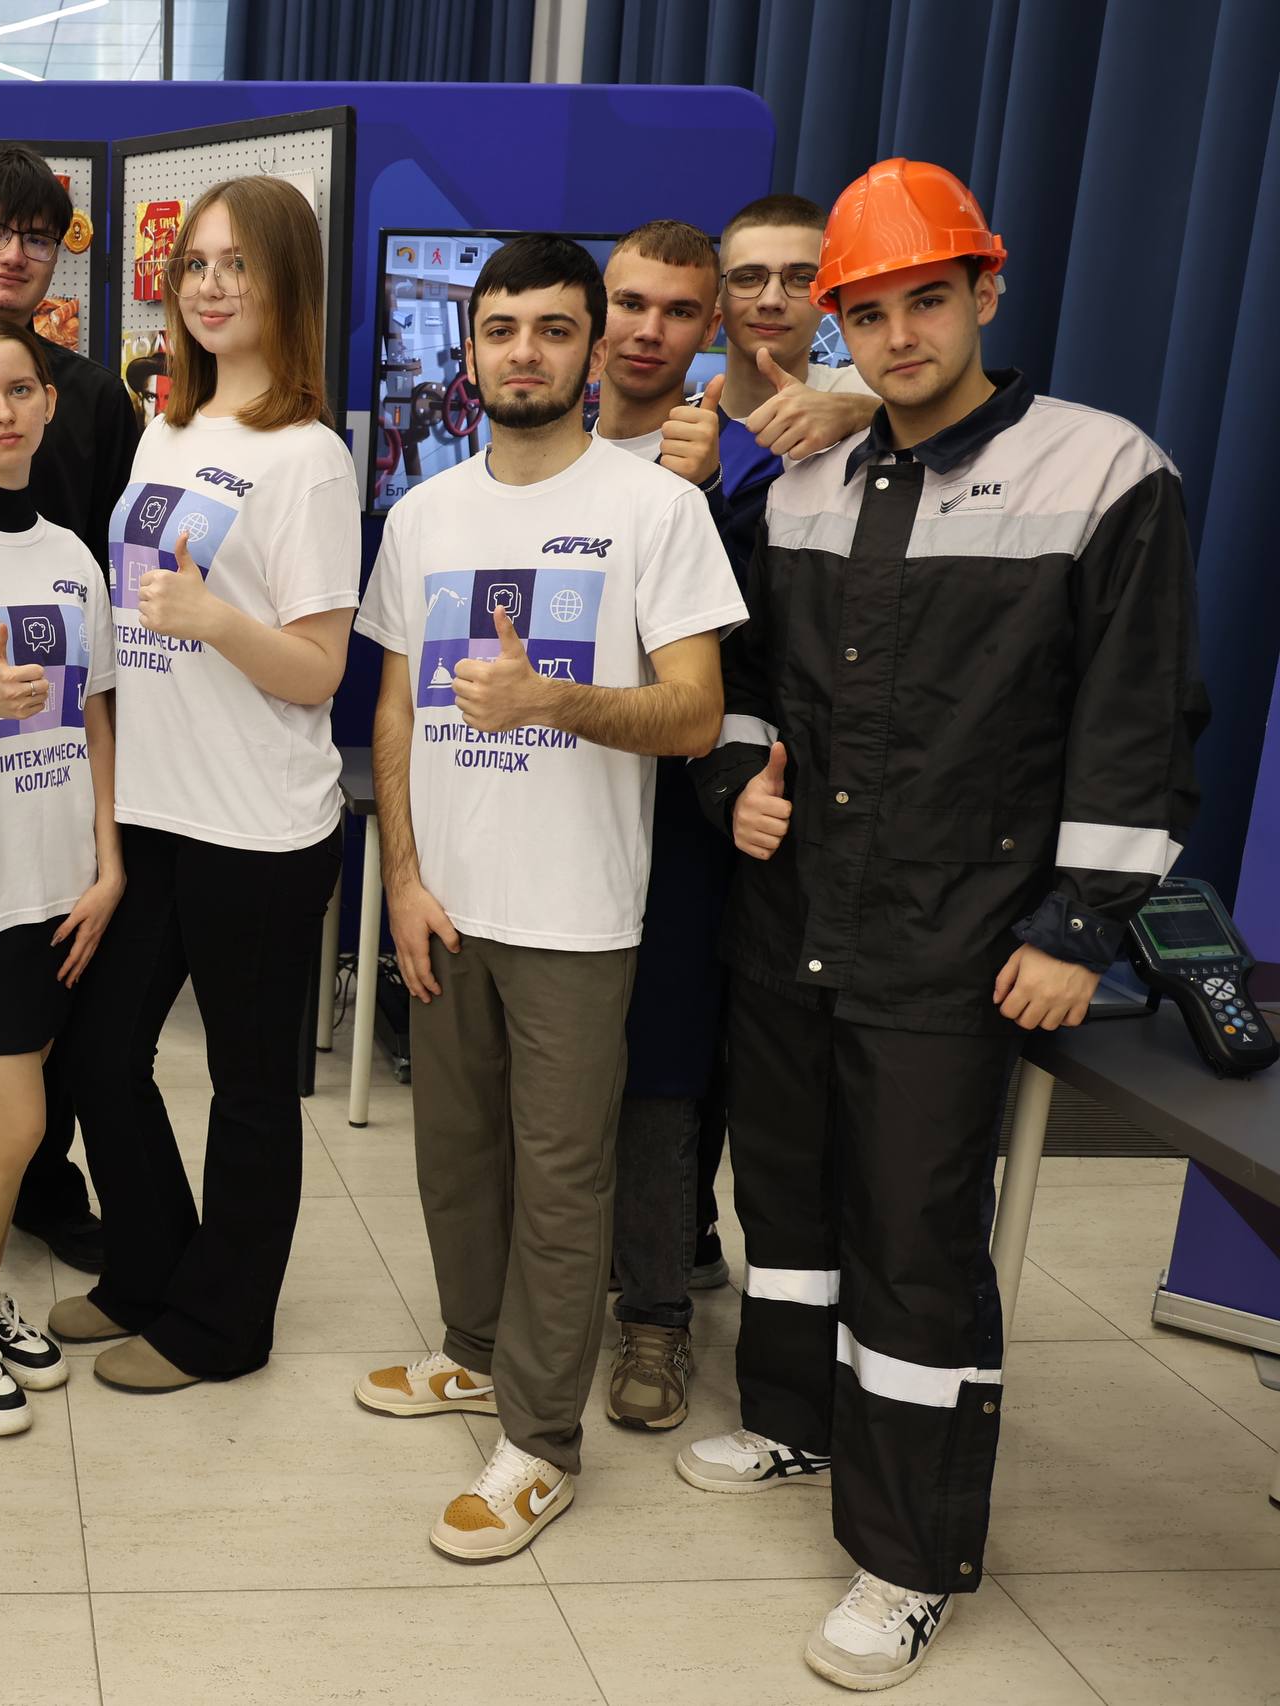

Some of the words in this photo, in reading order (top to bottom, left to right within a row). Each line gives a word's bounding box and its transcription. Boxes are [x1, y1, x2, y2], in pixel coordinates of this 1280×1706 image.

[970, 484, 1002, 497] БКЕ
[454, 748, 530, 773] КОЛЛЕДЖ
[14, 765, 71, 794] КОЛЛЕДЖ
